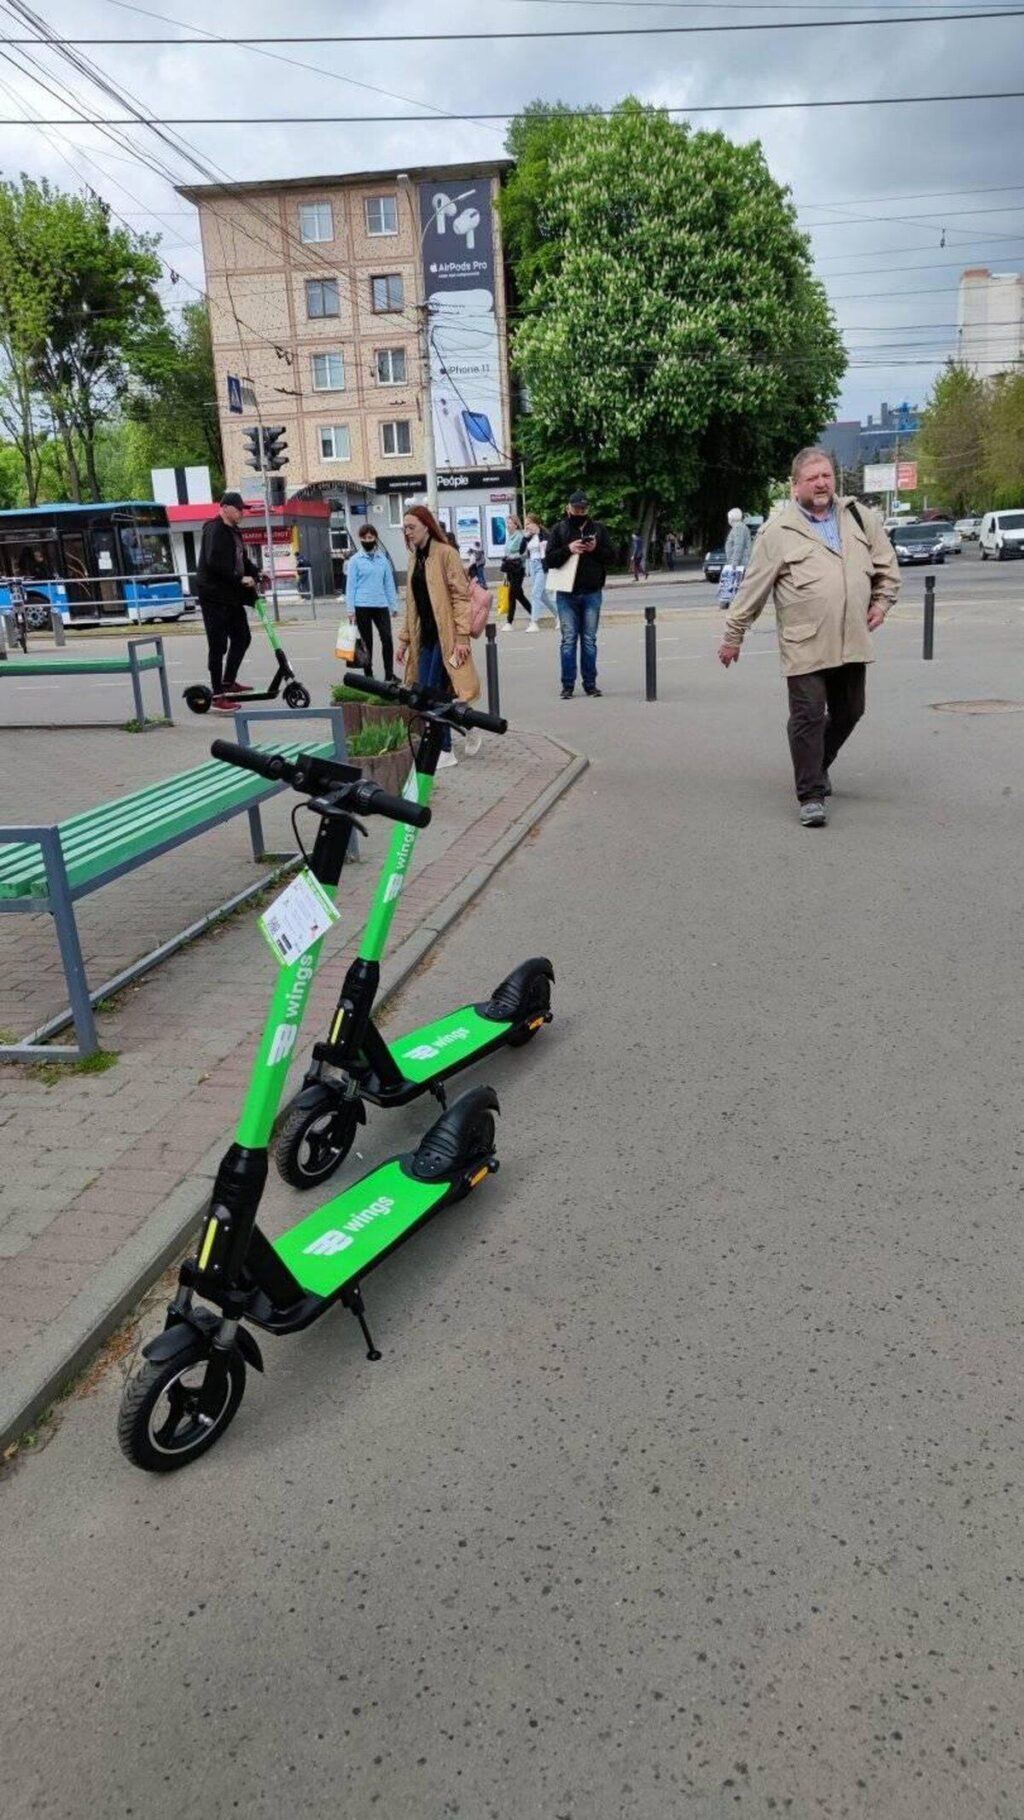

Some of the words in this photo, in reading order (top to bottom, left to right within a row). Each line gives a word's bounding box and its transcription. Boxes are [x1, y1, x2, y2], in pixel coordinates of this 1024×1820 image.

[438, 261, 471, 272] AirPods
[473, 260, 488, 270] Pro
[436, 474, 469, 488] People
[396, 824, 416, 870] wings
[286, 954, 313, 1019] wings
[431, 1026, 470, 1048] wings
[342, 1196, 395, 1232] wings
